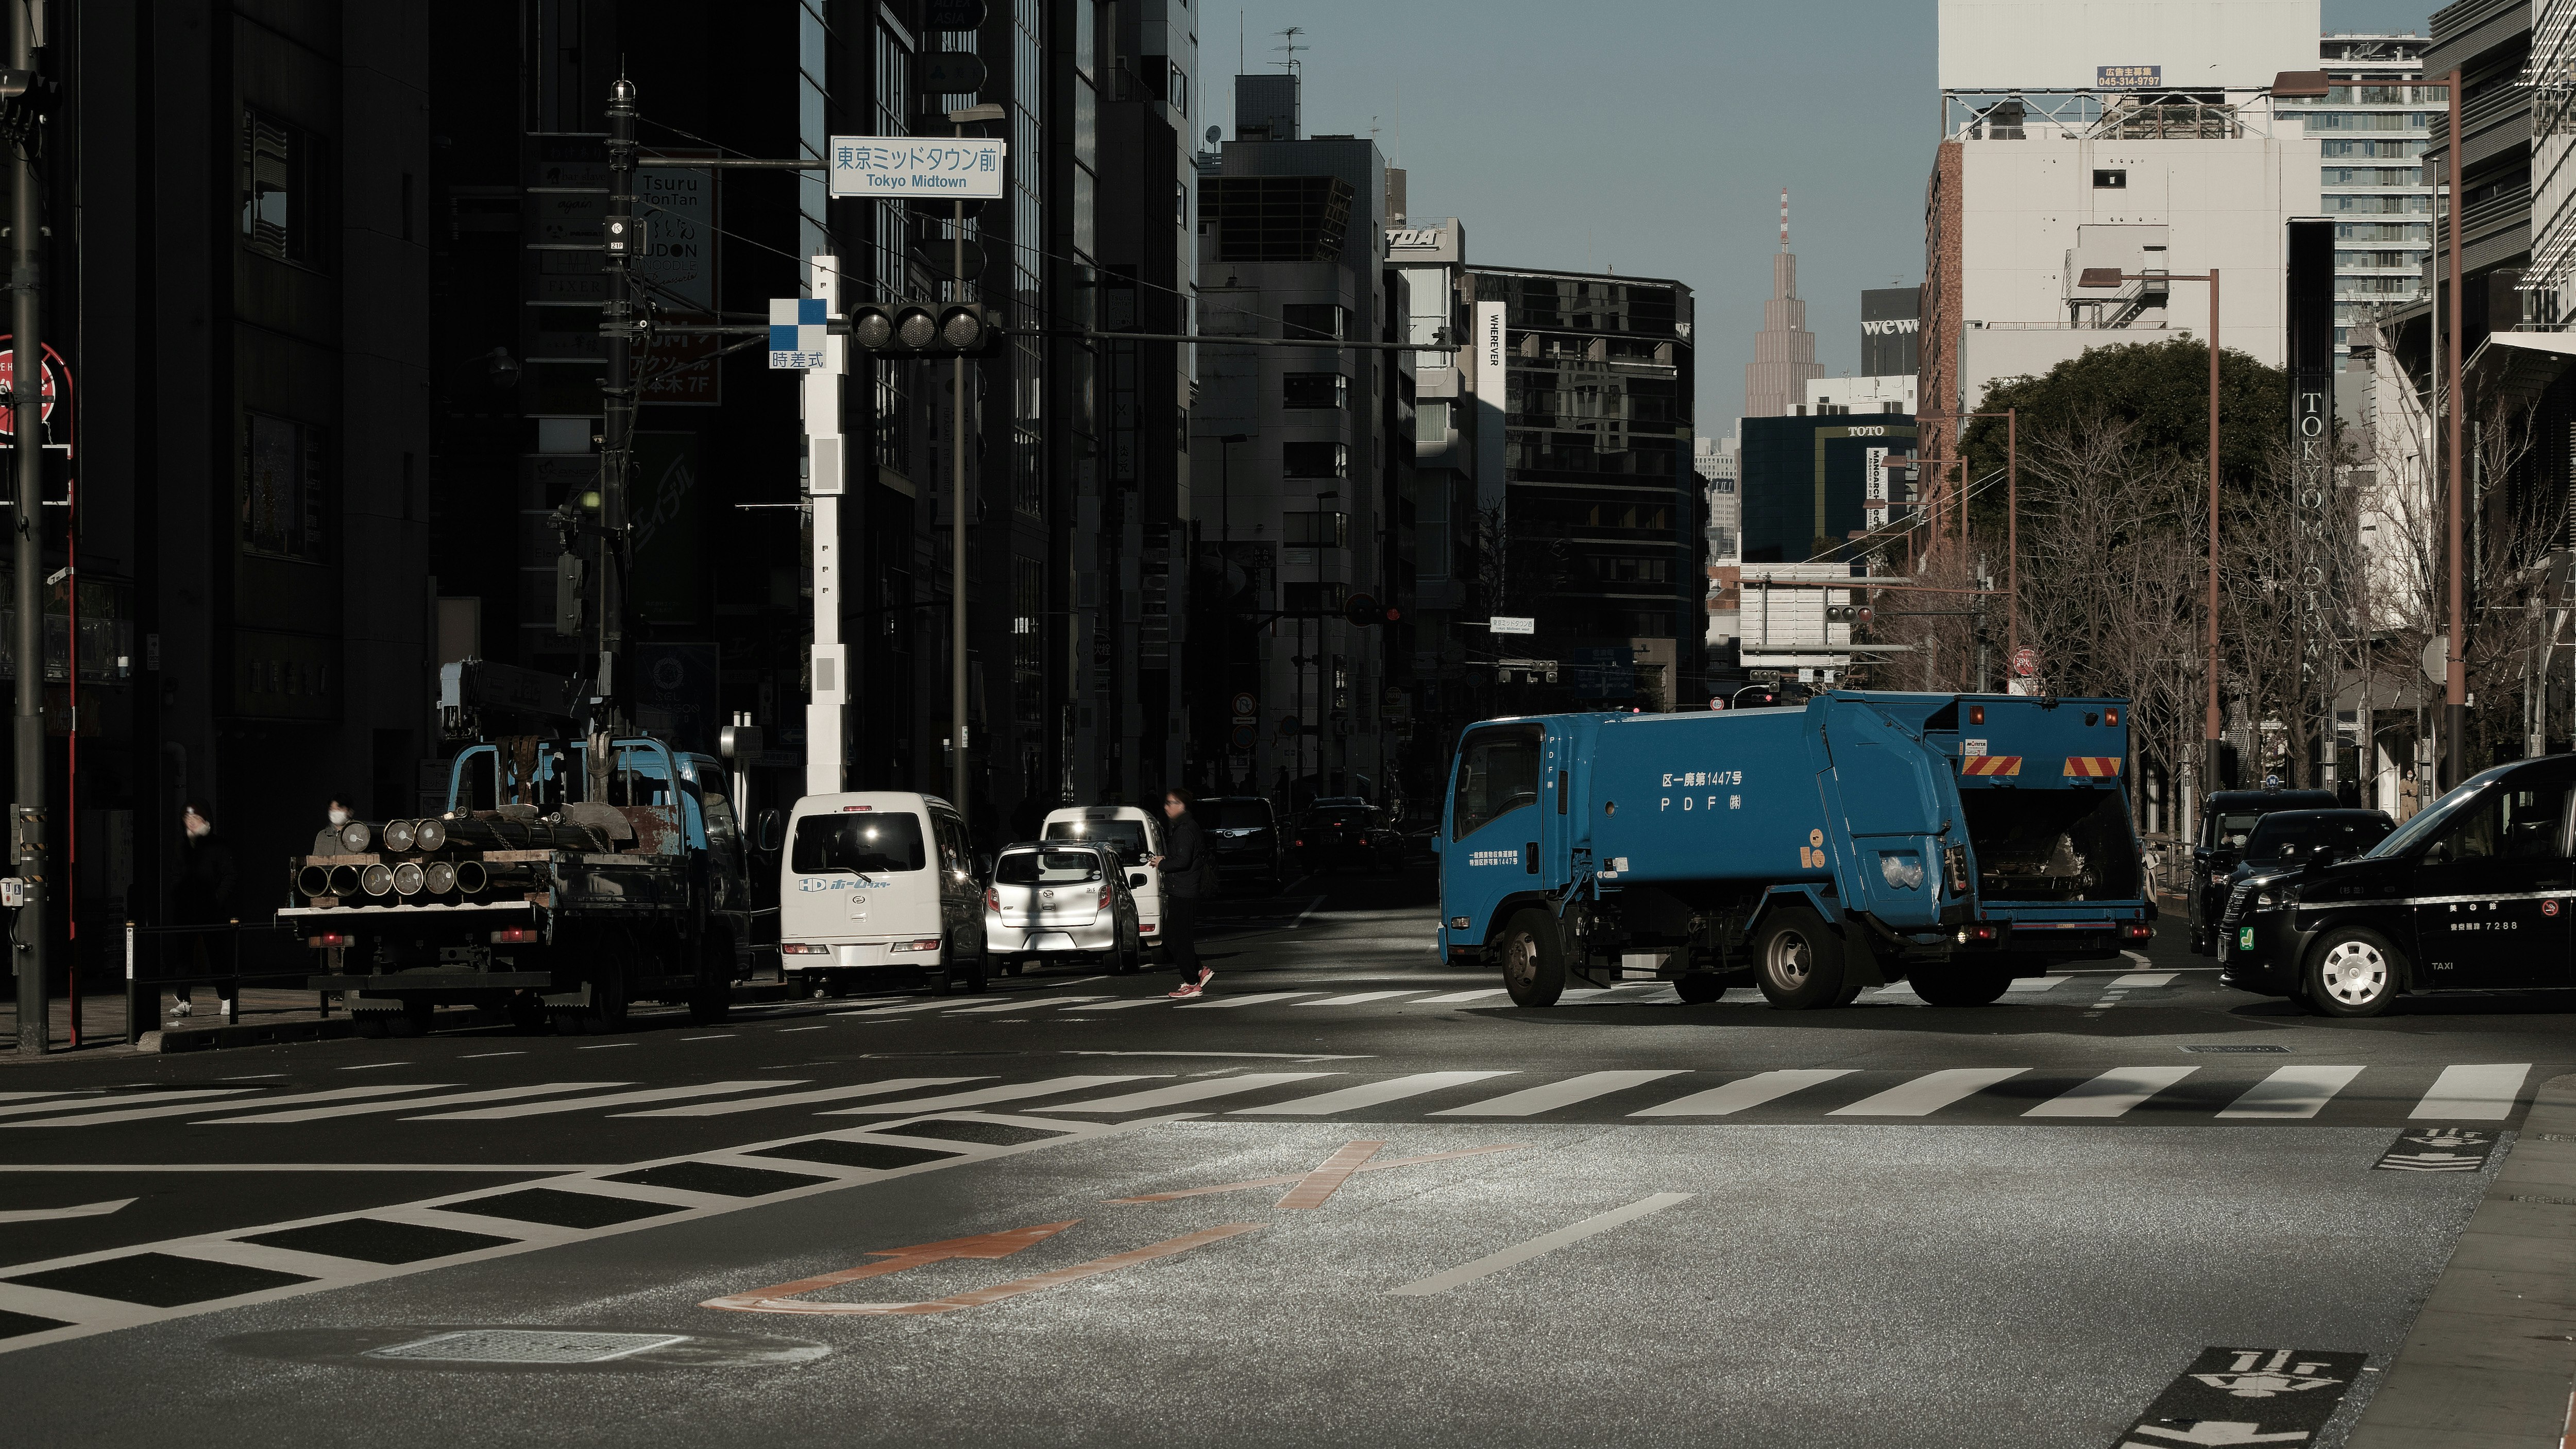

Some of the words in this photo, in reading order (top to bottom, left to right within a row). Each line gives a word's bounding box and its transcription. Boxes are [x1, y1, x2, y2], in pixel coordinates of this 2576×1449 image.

[934, 12, 964, 24] ASIA
[2099, 77, 2159, 86] 045-314-9797
[837, 146, 996, 172] 東京ミッドタウン前
[562, 168, 578, 180] bar
[643, 176, 697, 191] Tsuru
[867, 174, 906, 189] Tokyo
[912, 175, 967, 187] Midtown
[558, 197, 592, 214] again
[644, 193, 697, 205] TonTan
[1385, 230, 1435, 245] TOA
[644, 261, 697, 270] NOODLE
[549, 281, 600, 292] FIXER
[1490, 314, 1499, 366] WHEREVER
[773, 352, 823, 367] 時差式
[688, 377, 709, 393] 7F
[1848, 426, 1885, 437] TOTO
[1662, 771, 1742, 787] 区一廃第1447号
[799, 878, 826, 892] HD
[2450, 923, 2480, 931] 東京無線
[2486, 922, 2517, 930] 7288
